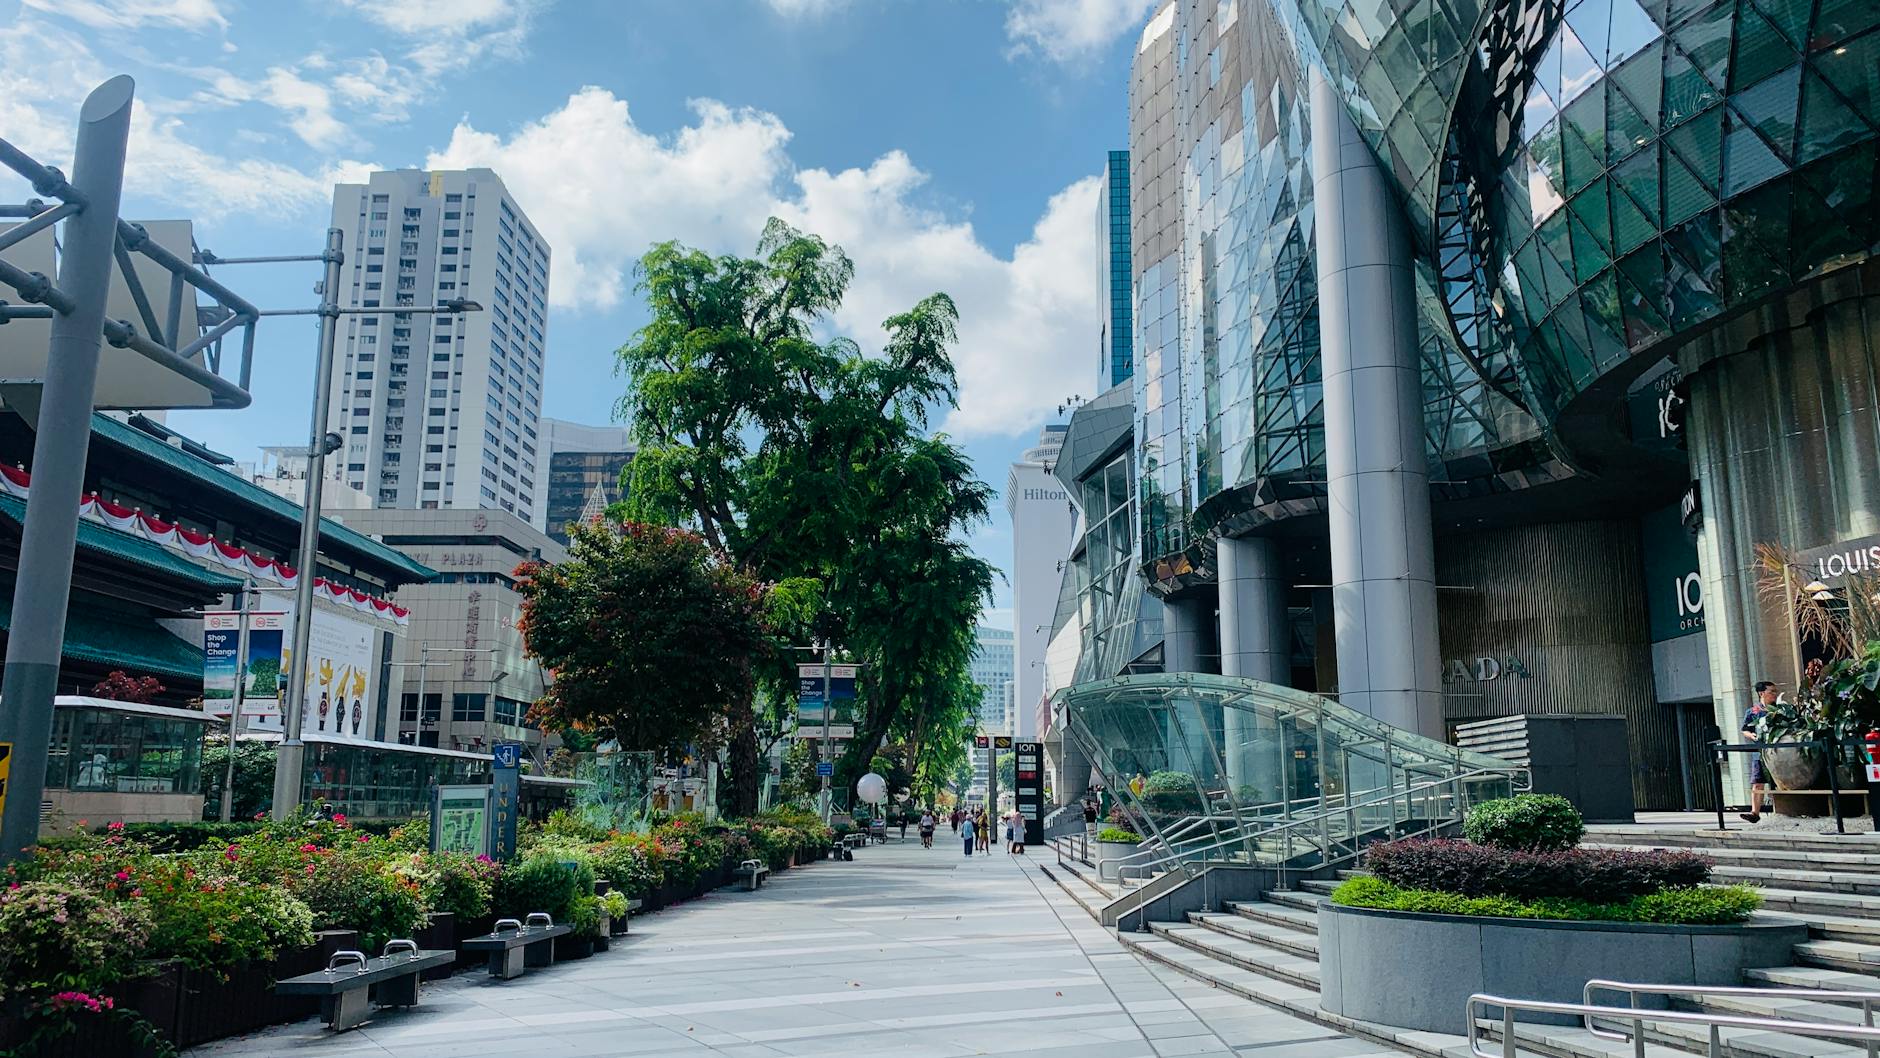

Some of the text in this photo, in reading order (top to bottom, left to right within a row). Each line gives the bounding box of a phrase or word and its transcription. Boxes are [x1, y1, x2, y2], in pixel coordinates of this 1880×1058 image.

[1024, 488, 1066, 500] Hilton
[441, 552, 483, 566] PLAZA
[1819, 546, 1880, 579] LOUIS
[207, 634, 227, 642] Shop
